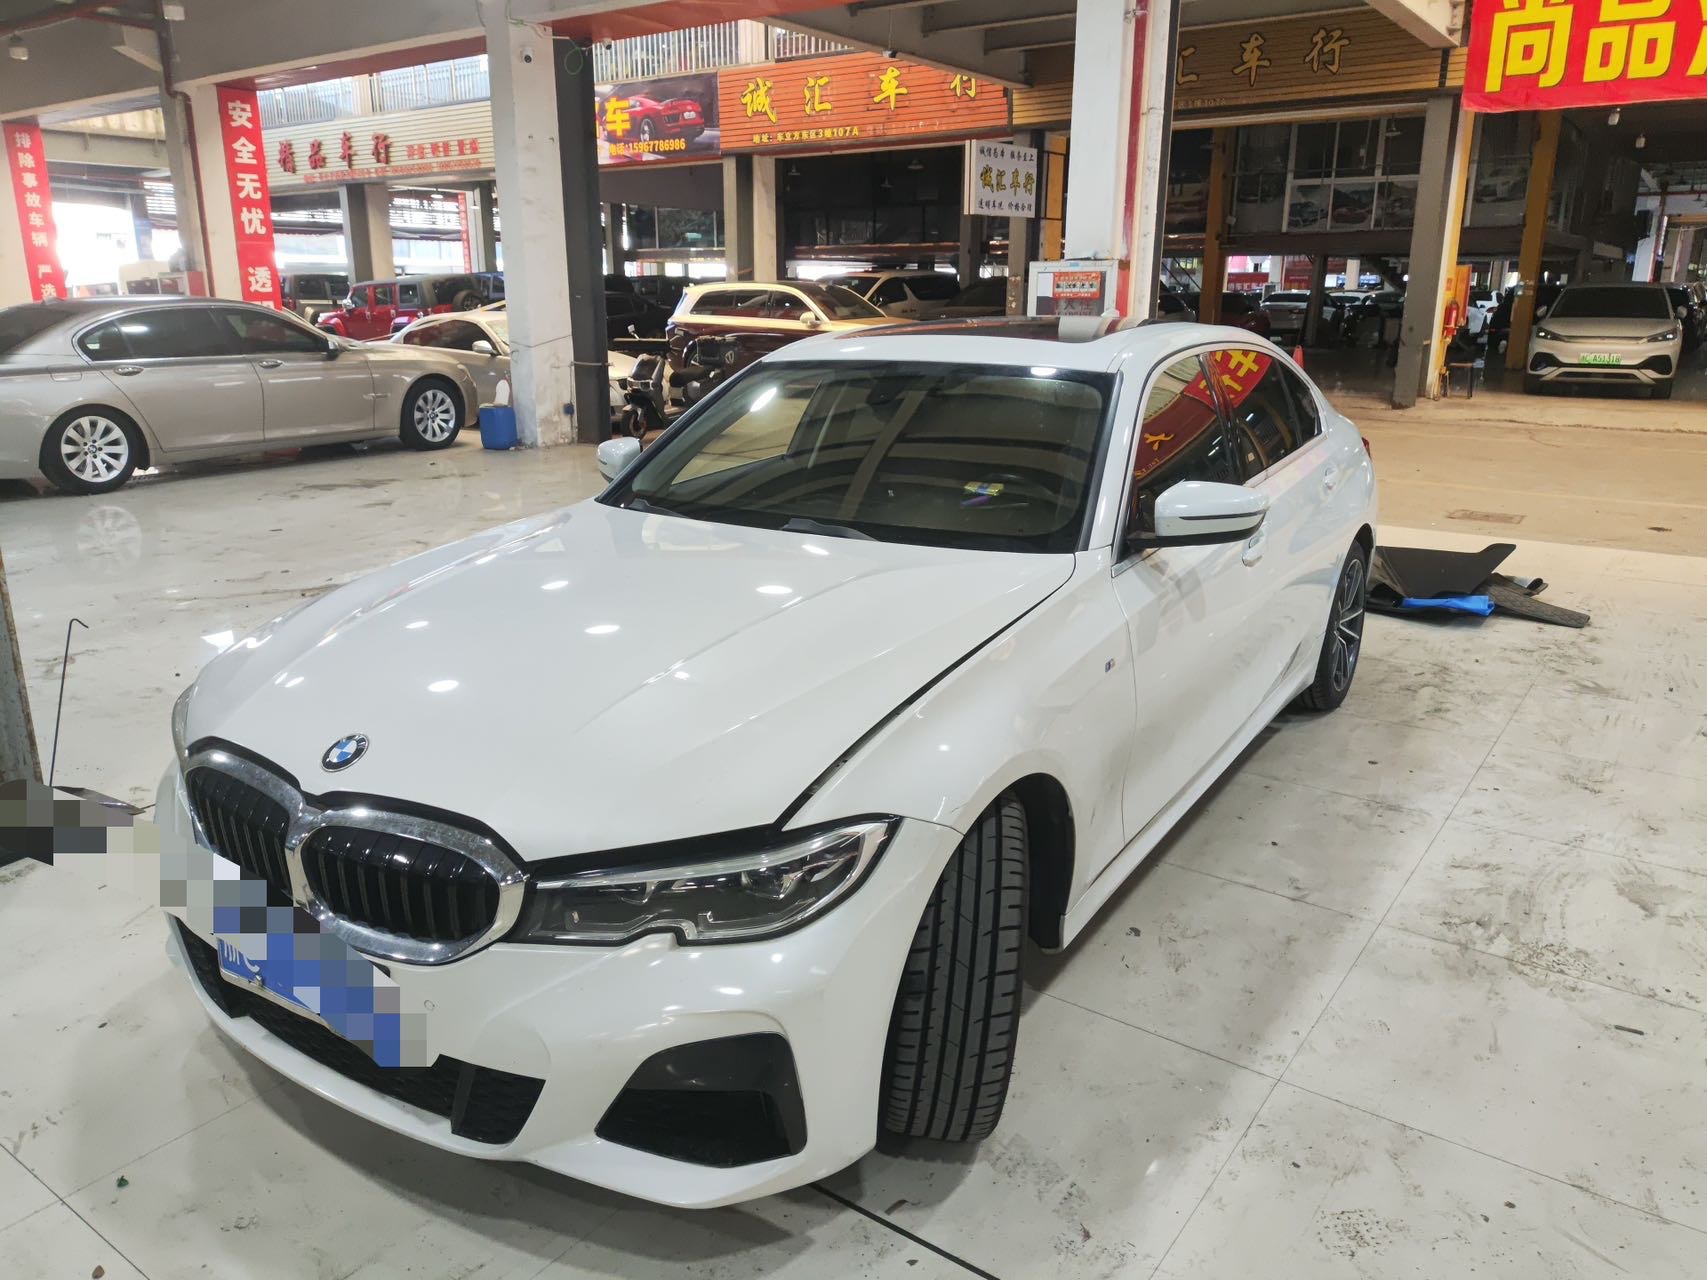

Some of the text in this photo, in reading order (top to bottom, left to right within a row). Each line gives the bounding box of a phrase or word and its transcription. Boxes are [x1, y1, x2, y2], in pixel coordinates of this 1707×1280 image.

[1485, 0, 1707, 93] 尚品
[14, 131, 49, 248] 排除事故车辆
[227, 99, 276, 311] 安全无忧 透
[980, 164, 1035, 196] 诚汇车行
